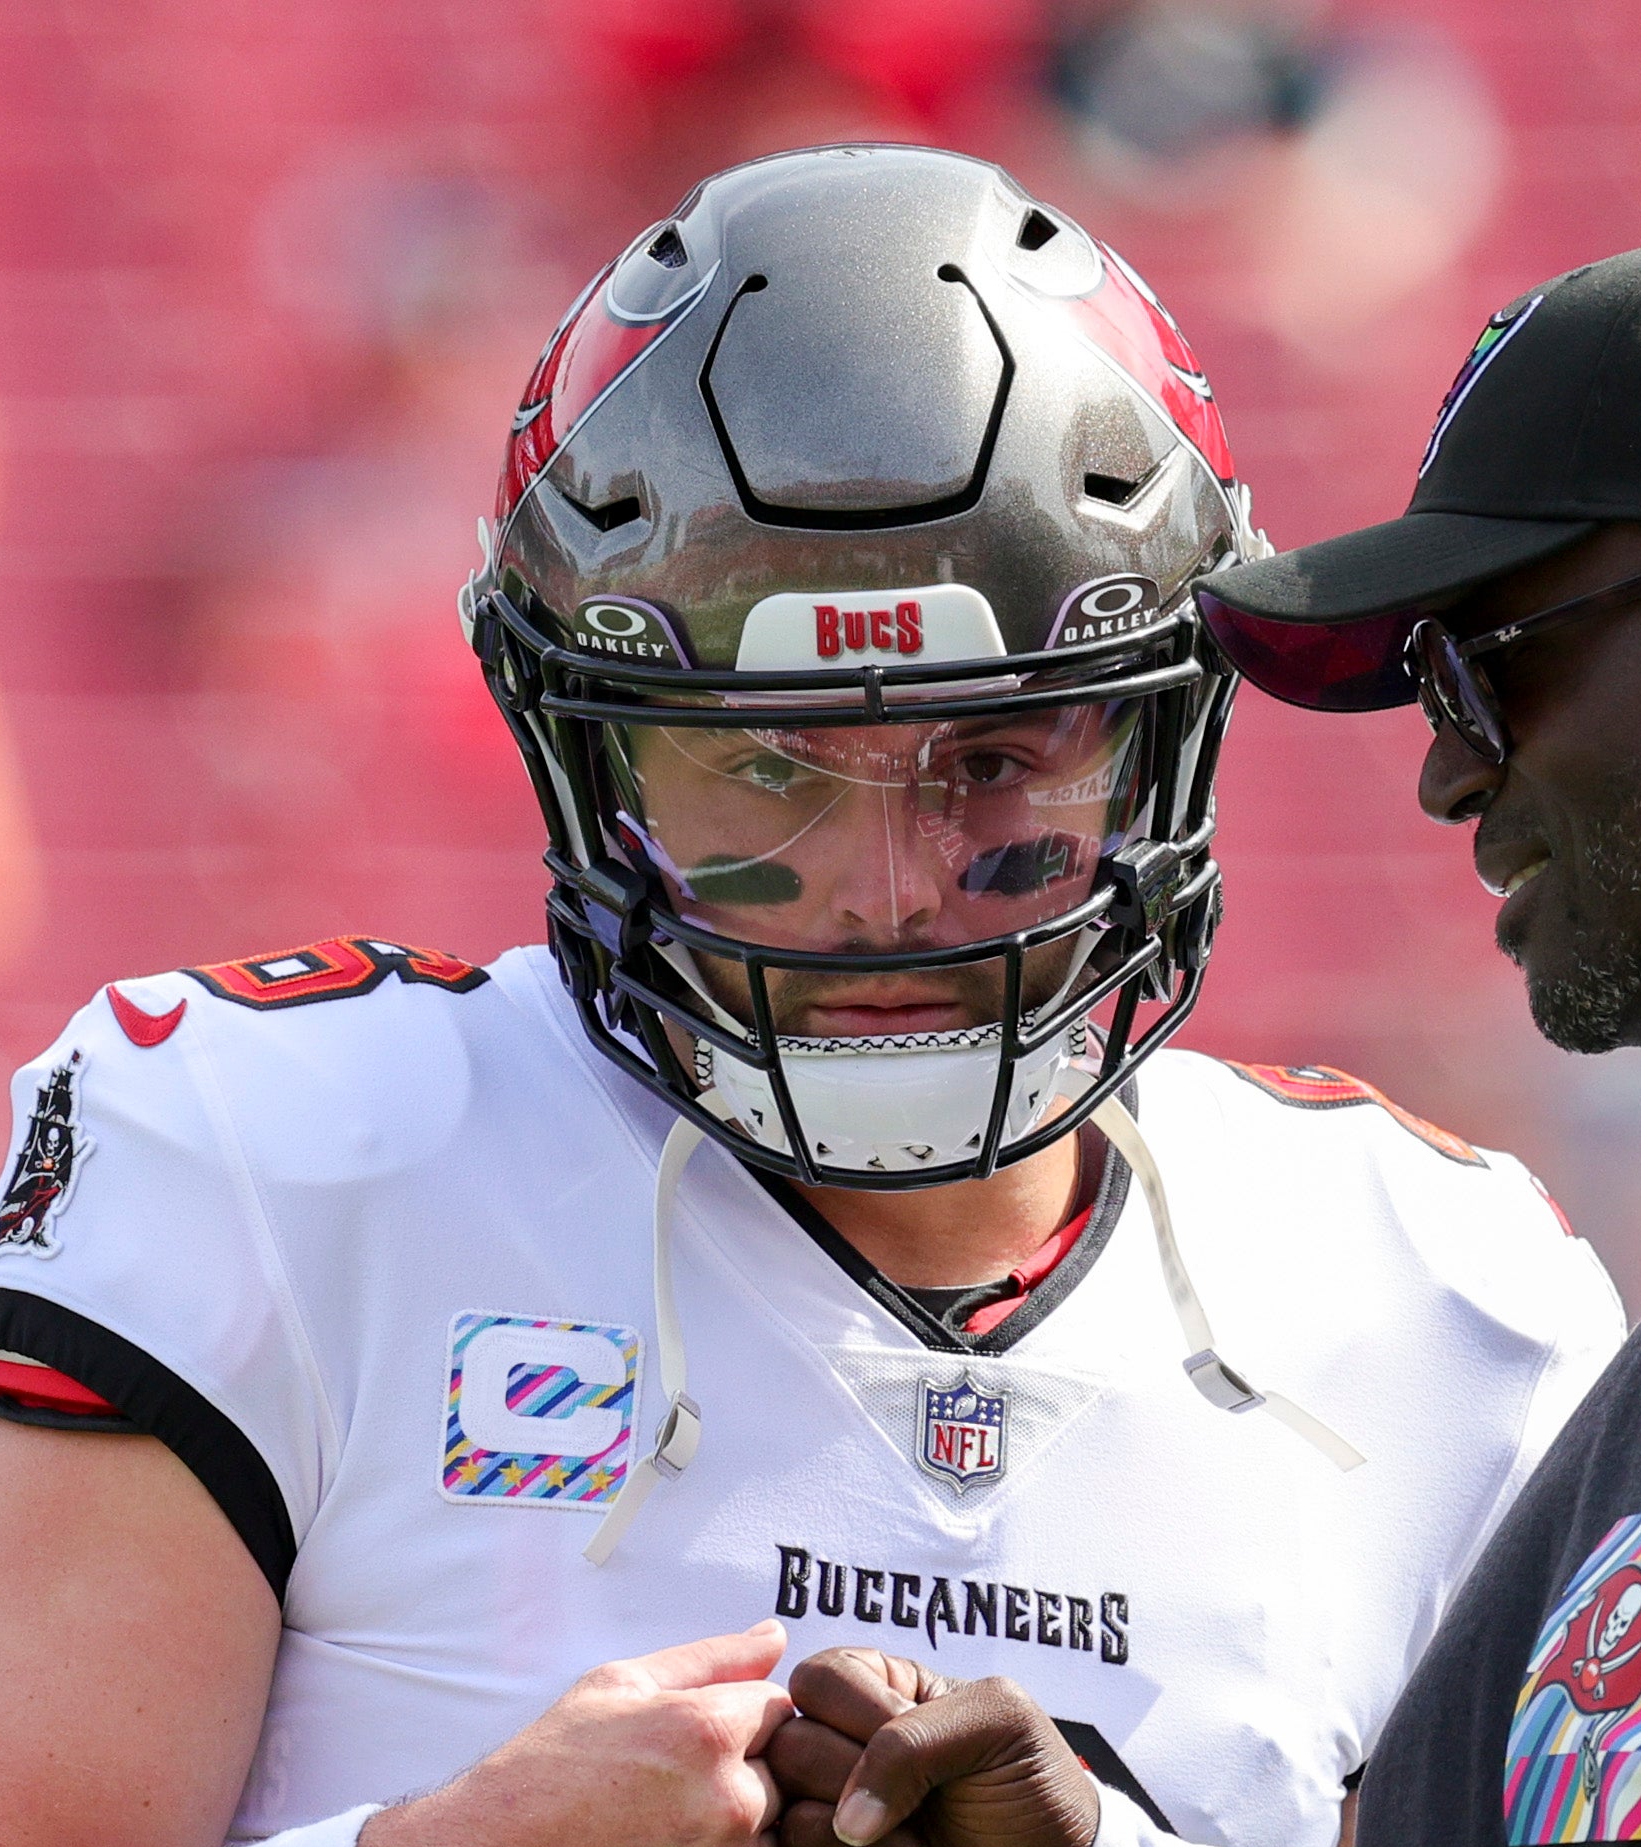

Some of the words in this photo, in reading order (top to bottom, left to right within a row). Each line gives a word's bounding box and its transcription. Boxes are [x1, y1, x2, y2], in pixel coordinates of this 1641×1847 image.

[576, 631, 665, 658] OAKLEY
[812, 600, 923, 657] BUCS
[1063, 608, 1155, 642] OAKLEY
[456, 1325, 627, 1459] C
[931, 1422, 995, 1471] NFL
[774, 1543, 1129, 1665] BUCCANEERS
